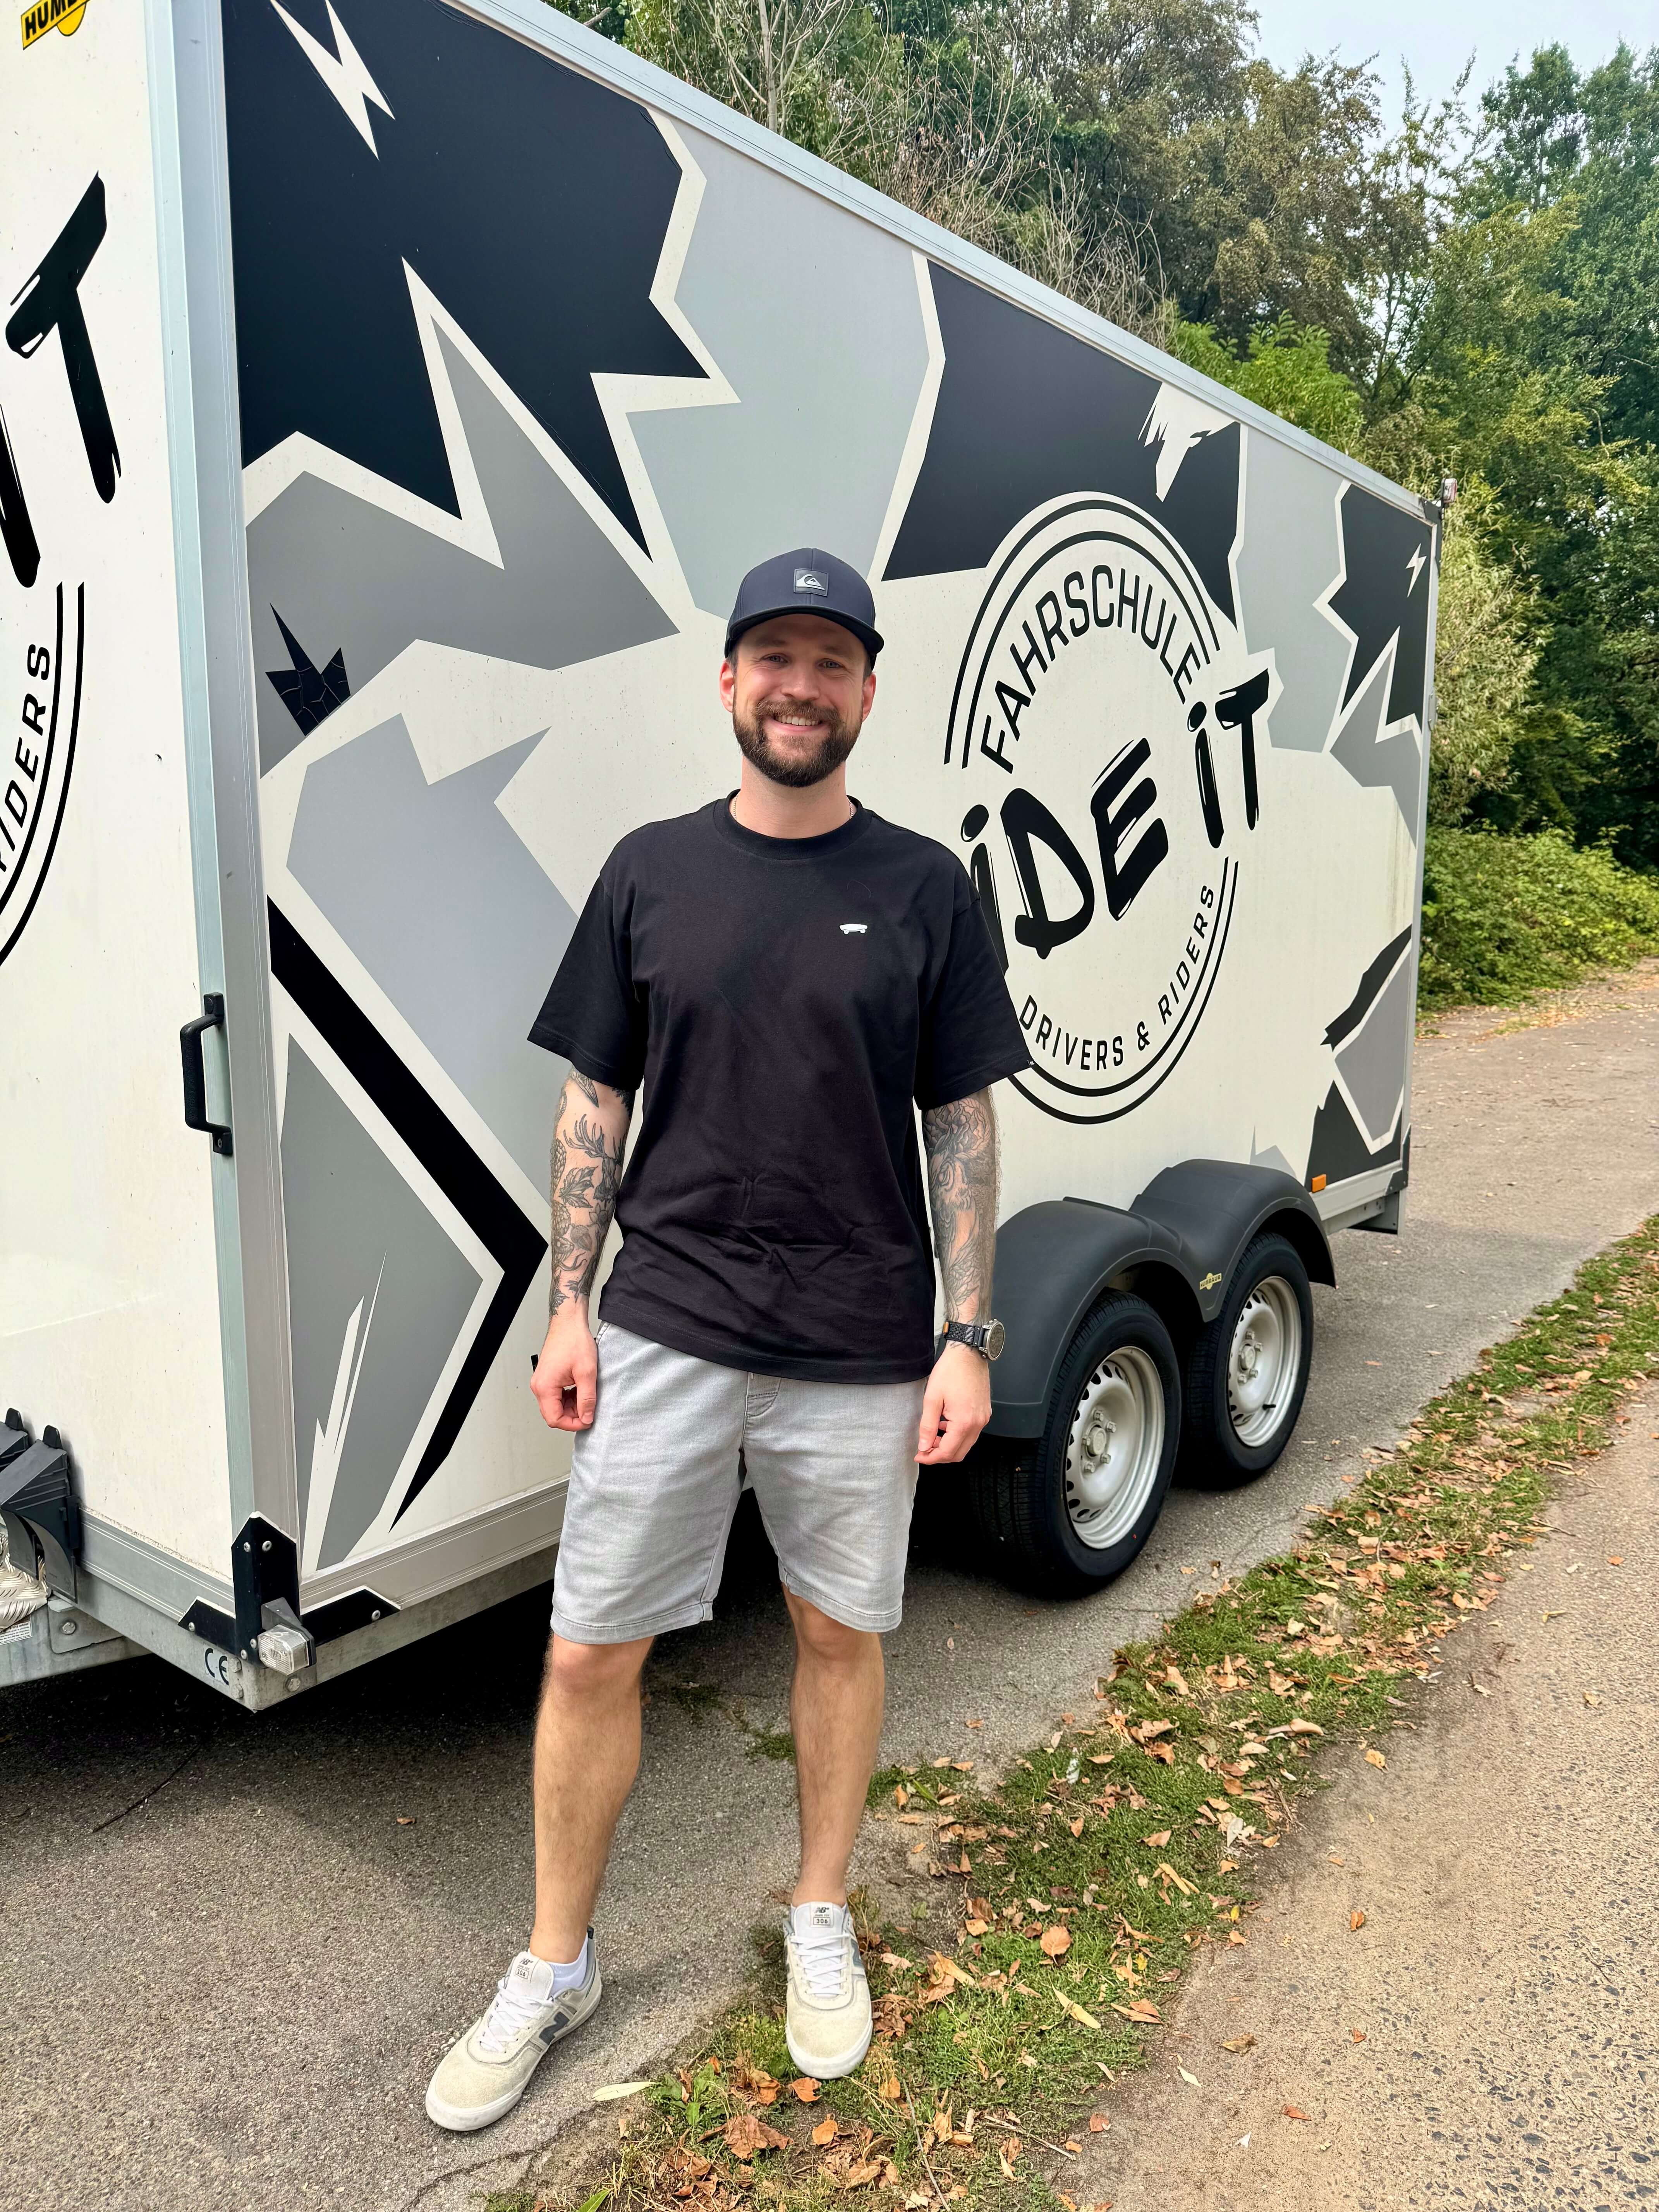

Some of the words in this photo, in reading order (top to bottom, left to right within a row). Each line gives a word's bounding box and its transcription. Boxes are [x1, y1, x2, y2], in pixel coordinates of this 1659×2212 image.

[0, 644, 50, 872] IDERS
[980, 565, 1201, 774] FAHRSCHULE
[1019, 994, 1123, 1071] DRIVERS
[1137, 1021, 1150, 1051] &
[1158, 885, 1214, 1025] RIDERS
